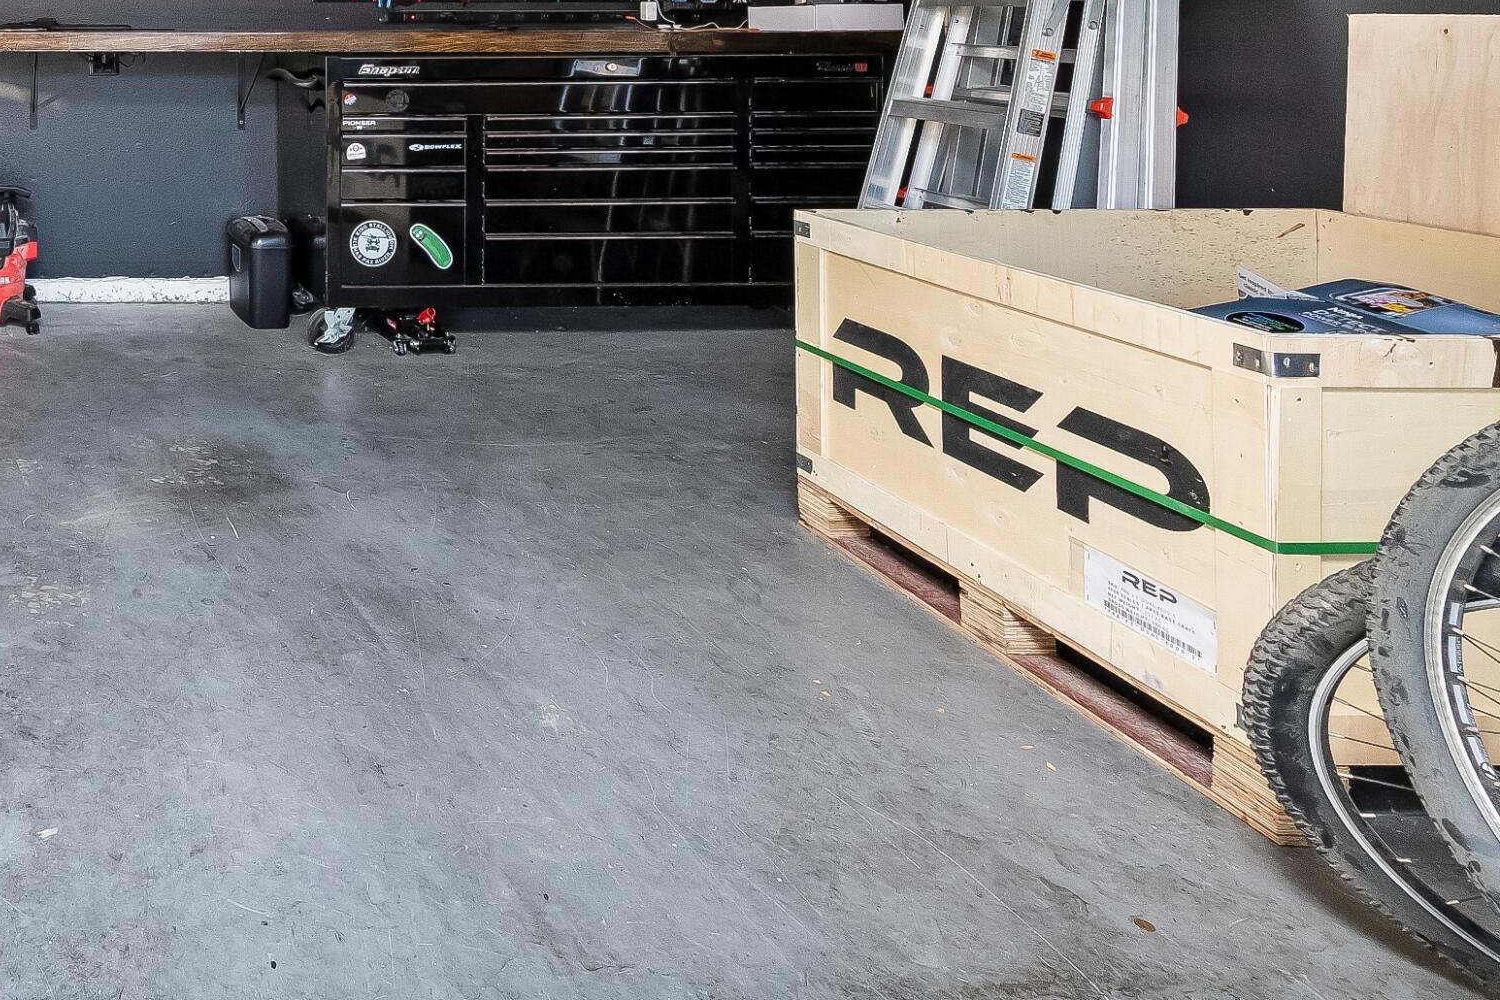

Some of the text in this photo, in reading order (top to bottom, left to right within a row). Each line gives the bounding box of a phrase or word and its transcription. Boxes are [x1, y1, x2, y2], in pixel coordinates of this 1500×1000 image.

[358, 64, 420, 77] Snap-on
[832, 318, 1212, 533] REP
[1121, 570, 1178, 604] REP
